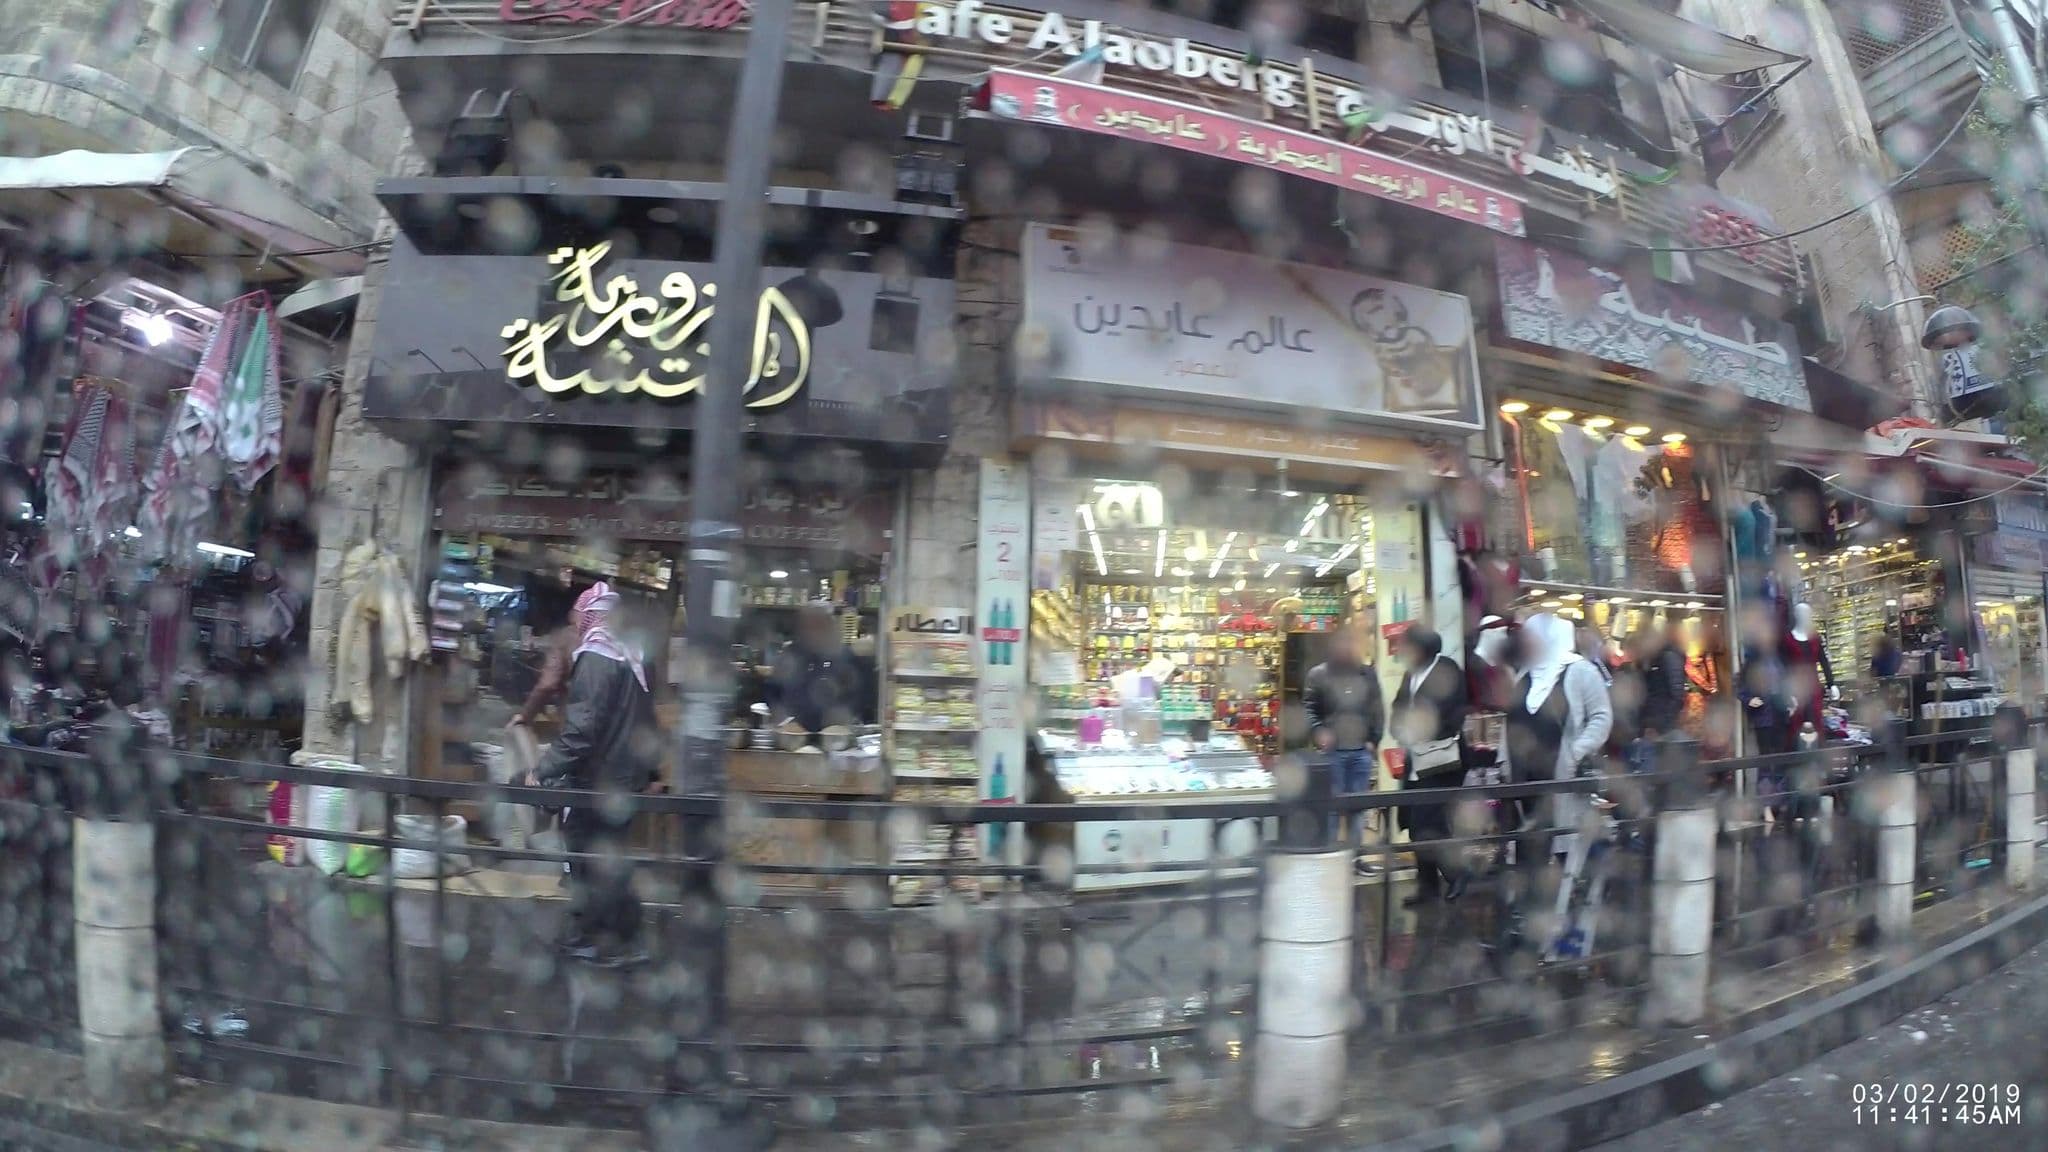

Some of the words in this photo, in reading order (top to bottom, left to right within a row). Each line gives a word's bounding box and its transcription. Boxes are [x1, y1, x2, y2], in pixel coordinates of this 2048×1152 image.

[1073, 295, 1213, 343] عابدين
[1228, 314, 1315, 355] عالم
[997, 541, 1011, 563] 2
